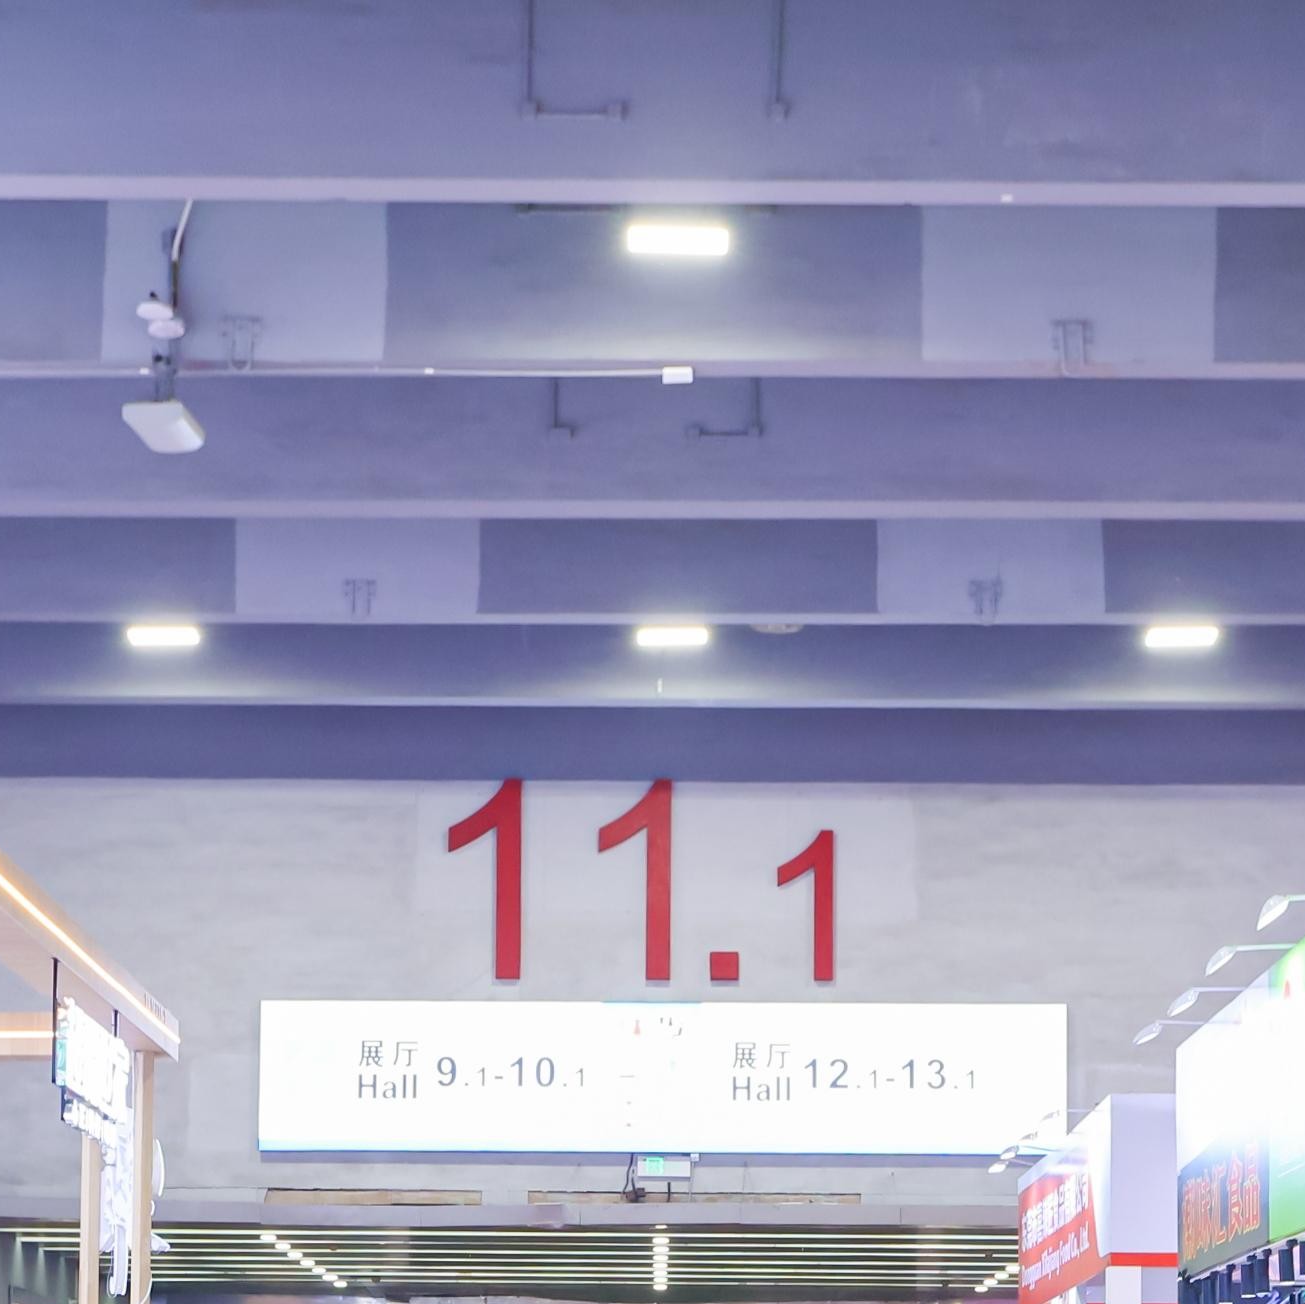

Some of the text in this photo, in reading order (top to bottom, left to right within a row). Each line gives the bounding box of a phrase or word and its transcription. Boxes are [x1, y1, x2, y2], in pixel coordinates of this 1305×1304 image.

[448, 778, 834, 981] 11.1
[359, 1040, 418, 1067] 展厅
[733, 1042, 791, 1069] 展厅
[358, 1074, 417, 1099] Hall
[733, 1076, 791, 1102] Hall
